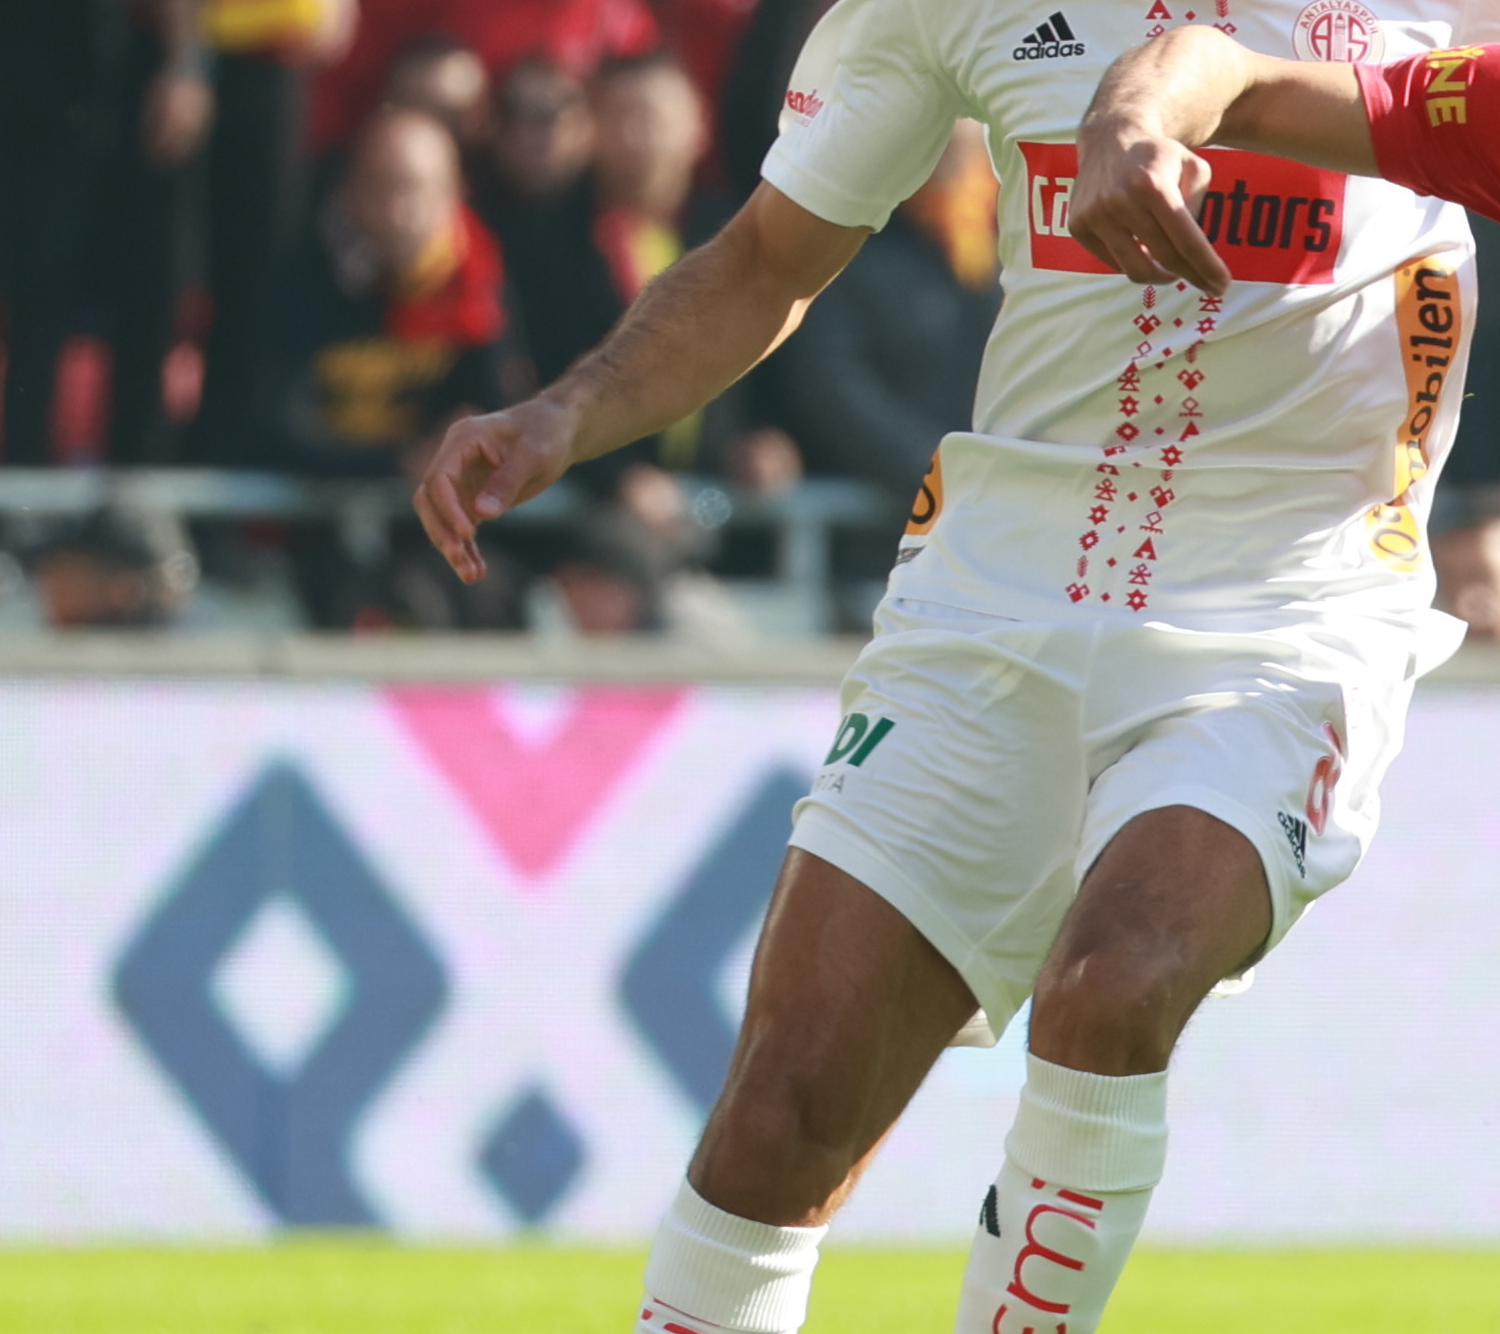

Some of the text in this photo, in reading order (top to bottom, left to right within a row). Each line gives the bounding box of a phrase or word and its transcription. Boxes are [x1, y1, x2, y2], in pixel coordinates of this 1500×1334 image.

[1012, 41, 1085, 61] adidas
[1031, 174, 1336, 252] ca otors
[823, 712, 896, 768] DI
